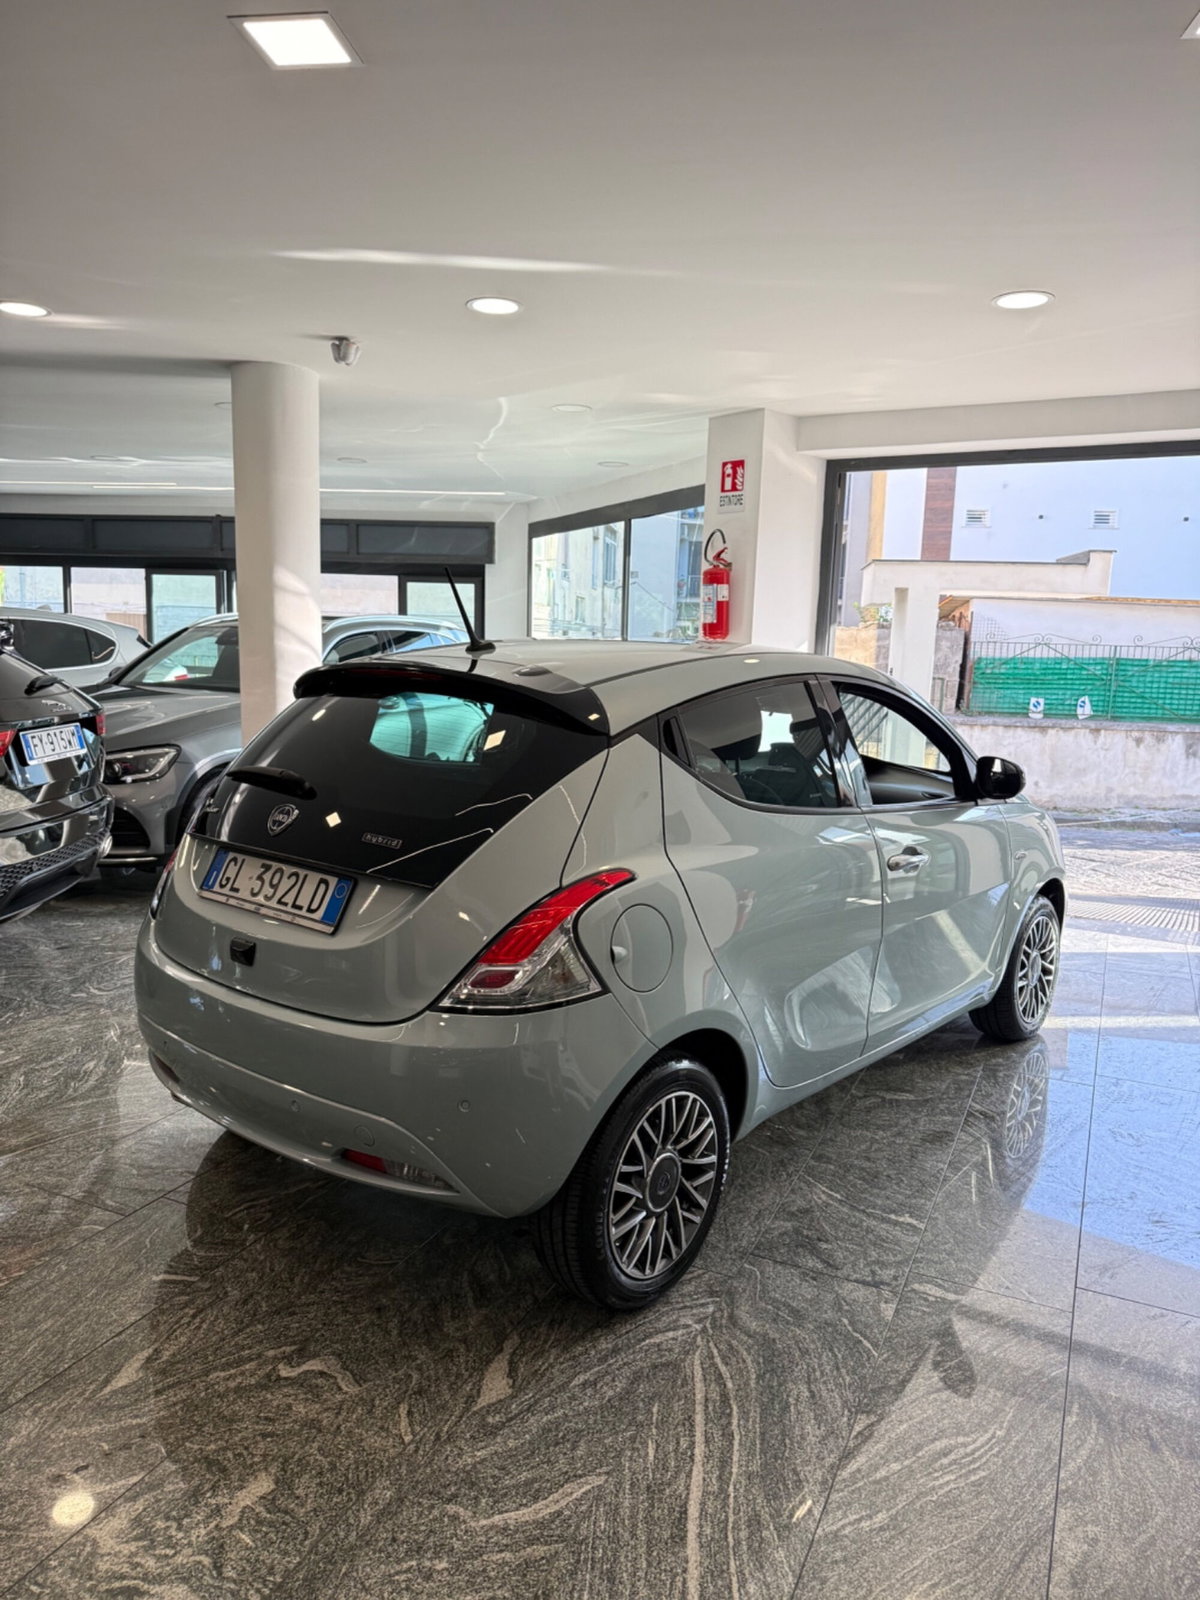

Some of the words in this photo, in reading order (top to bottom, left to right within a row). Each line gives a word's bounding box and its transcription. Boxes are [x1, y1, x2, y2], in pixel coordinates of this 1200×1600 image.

[30, 733, 46, 757] FY
[218, 855, 246, 893] GL
[250, 862, 330, 914] 392LD
